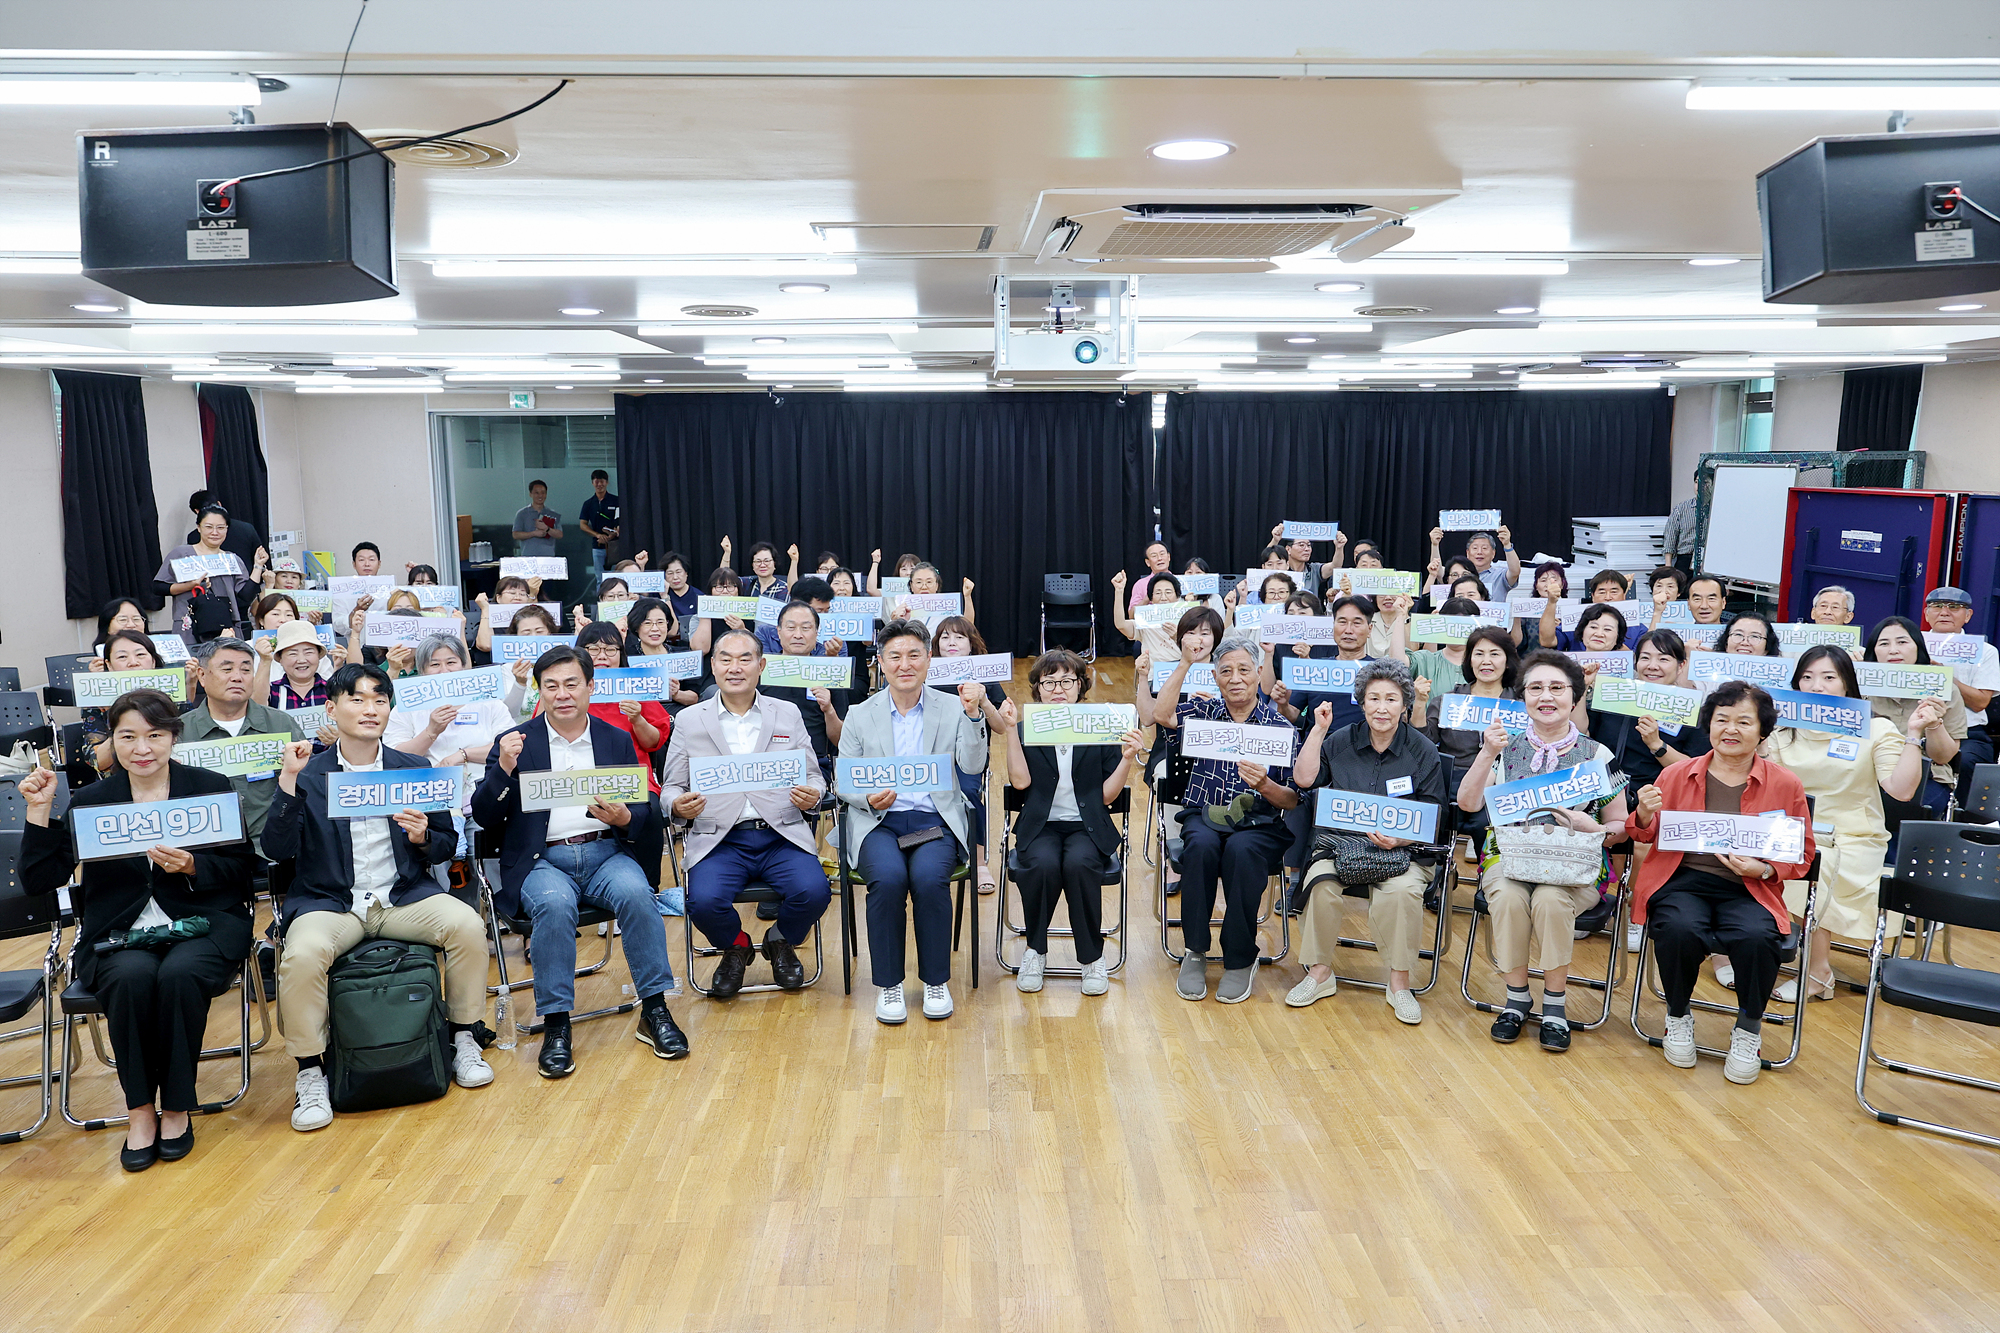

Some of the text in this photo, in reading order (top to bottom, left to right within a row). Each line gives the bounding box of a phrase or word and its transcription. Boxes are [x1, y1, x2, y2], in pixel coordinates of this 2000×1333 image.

[95, 141, 110, 159] R
[198, 219, 237, 229] LAST
[1925, 220, 1961, 230] LAST
[1289, 524, 1332, 536] 민선 9기
[1447, 513, 1492, 526] 민선 9기
[1956, 503, 1968, 562] CHAMPION
[1355, 576, 1380, 589] 개발
[701, 600, 725, 613] 개발
[367, 622, 392, 636] 교통
[393, 619, 419, 634] 주거
[838, 619, 863, 636] 9기
[1263, 624, 1284, 636] 교통
[1285, 621, 1306, 633] 주거
[1416, 617, 1447, 635] 돌봄
[1779, 630, 1856, 647] 개발 대전환
[502, 641, 538, 659] 민선
[767, 657, 847, 682] 돌봄 대전환
[926, 664, 950, 680] 교통
[951, 659, 974, 676] 주거
[974, 663, 1008, 678] 대전환
[1292, 665, 1328, 686] 민선
[1694, 658, 1788, 681] 문화 대전환
[80, 677, 118, 697] 개발
[399, 674, 498, 707] 문화 대전환
[615, 676, 665, 696] 대전환
[1887, 671, 1947, 690] 대전환
[1601, 682, 1695, 717] 돌봄 대전환
[1031, 706, 1129, 734] 돌봄 대전환
[1800, 701, 1864, 730] 대전환
[1186, 728, 1289, 757] 교통 주거 대전환
[178, 749, 223, 768] 개발
[223, 739, 285, 764] 대전환
[695, 758, 801, 792] 문화 대전환
[850, 762, 939, 789] 민선 9기
[338, 778, 456, 807] 경제 대전환
[528, 774, 641, 800] 개발 대전환
[1494, 771, 1603, 816] 경제 대전환
[95, 802, 223, 845] 민선 9기
[1331, 798, 1421, 834] 민선 9기
[1662, 822, 1697, 841] 교통
[1699, 818, 1736, 838] 주거
